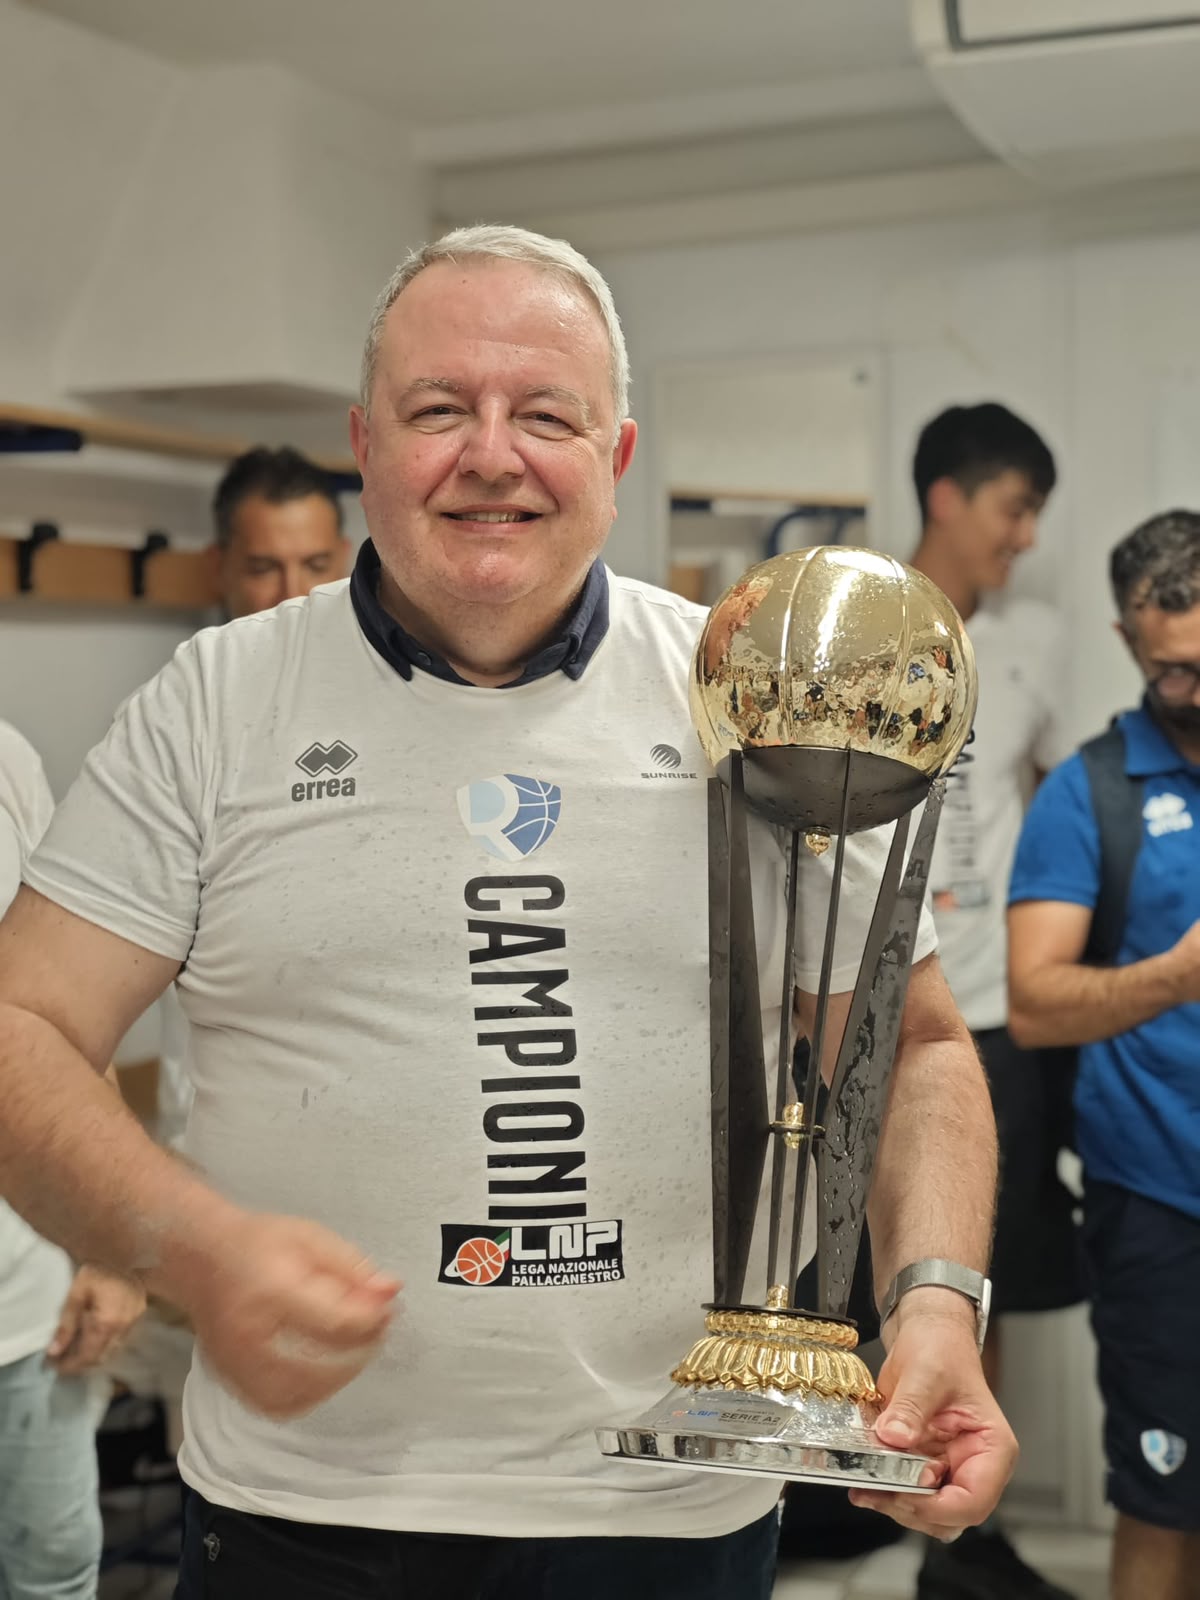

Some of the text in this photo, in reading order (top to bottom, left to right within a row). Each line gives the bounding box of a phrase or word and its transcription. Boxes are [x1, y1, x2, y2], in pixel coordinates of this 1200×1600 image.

[291, 777, 356, 802] errea
[464, 875, 587, 1220] CAMPIONI
[511, 1220, 618, 1260] LNP
[512, 1258, 618, 1275] LEGA NAZIONALE
[512, 1269, 621, 1286] PALLACANESTRO
[721, 1411, 762, 1422] SERIE
[763, 1415, 782, 1423] A2
